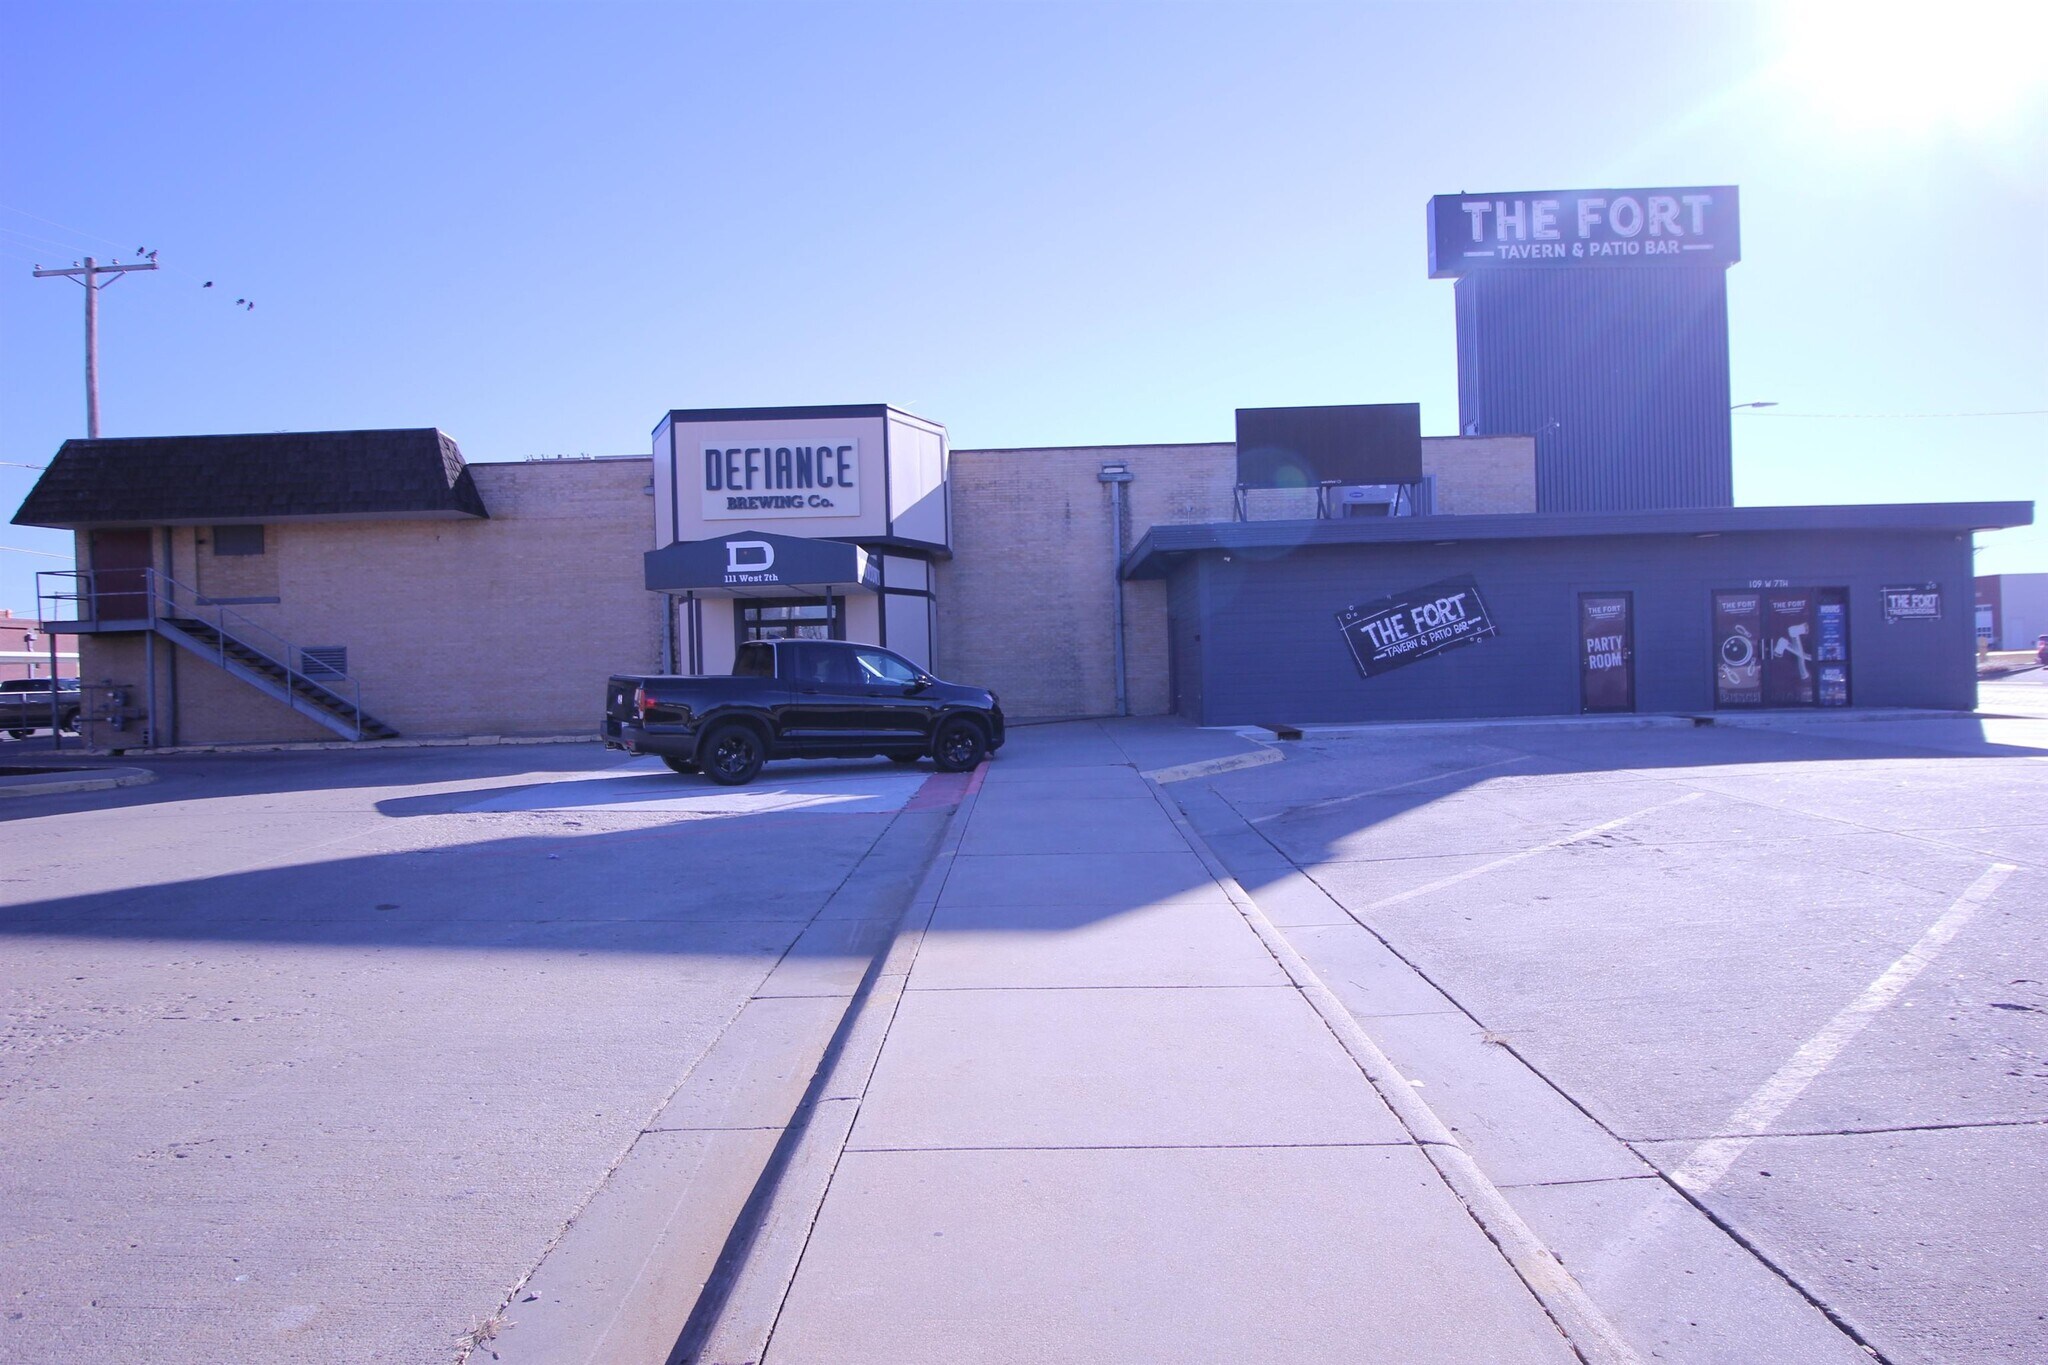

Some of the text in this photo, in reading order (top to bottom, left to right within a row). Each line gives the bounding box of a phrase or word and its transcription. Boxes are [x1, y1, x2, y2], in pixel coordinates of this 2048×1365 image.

[1462, 195, 1713, 242] THE FORT
[1498, 240, 1680, 260] TAVERN & PATIO BAR
[705, 446, 854, 491] DEFIANCE
[727, 494, 834, 510] BREWING Co.
[726, 540, 775, 573] D
[724, 574, 779, 583] 111 West 7th
[1749, 579, 1789, 588] 109 W 7TH
[1602, 605, 1621, 613] FORT
[1737, 600, 1756, 608] FORT
[1787, 600, 1806, 608] FORT
[1888, 594, 1938, 608] THE FORT
[1360, 593, 1466, 648] THE FORT
[1385, 620, 1470, 658] TAVERN & PATIO BAR
[1587, 636, 1622, 652] PARTY
[1589, 652, 1622, 669] ROOM
